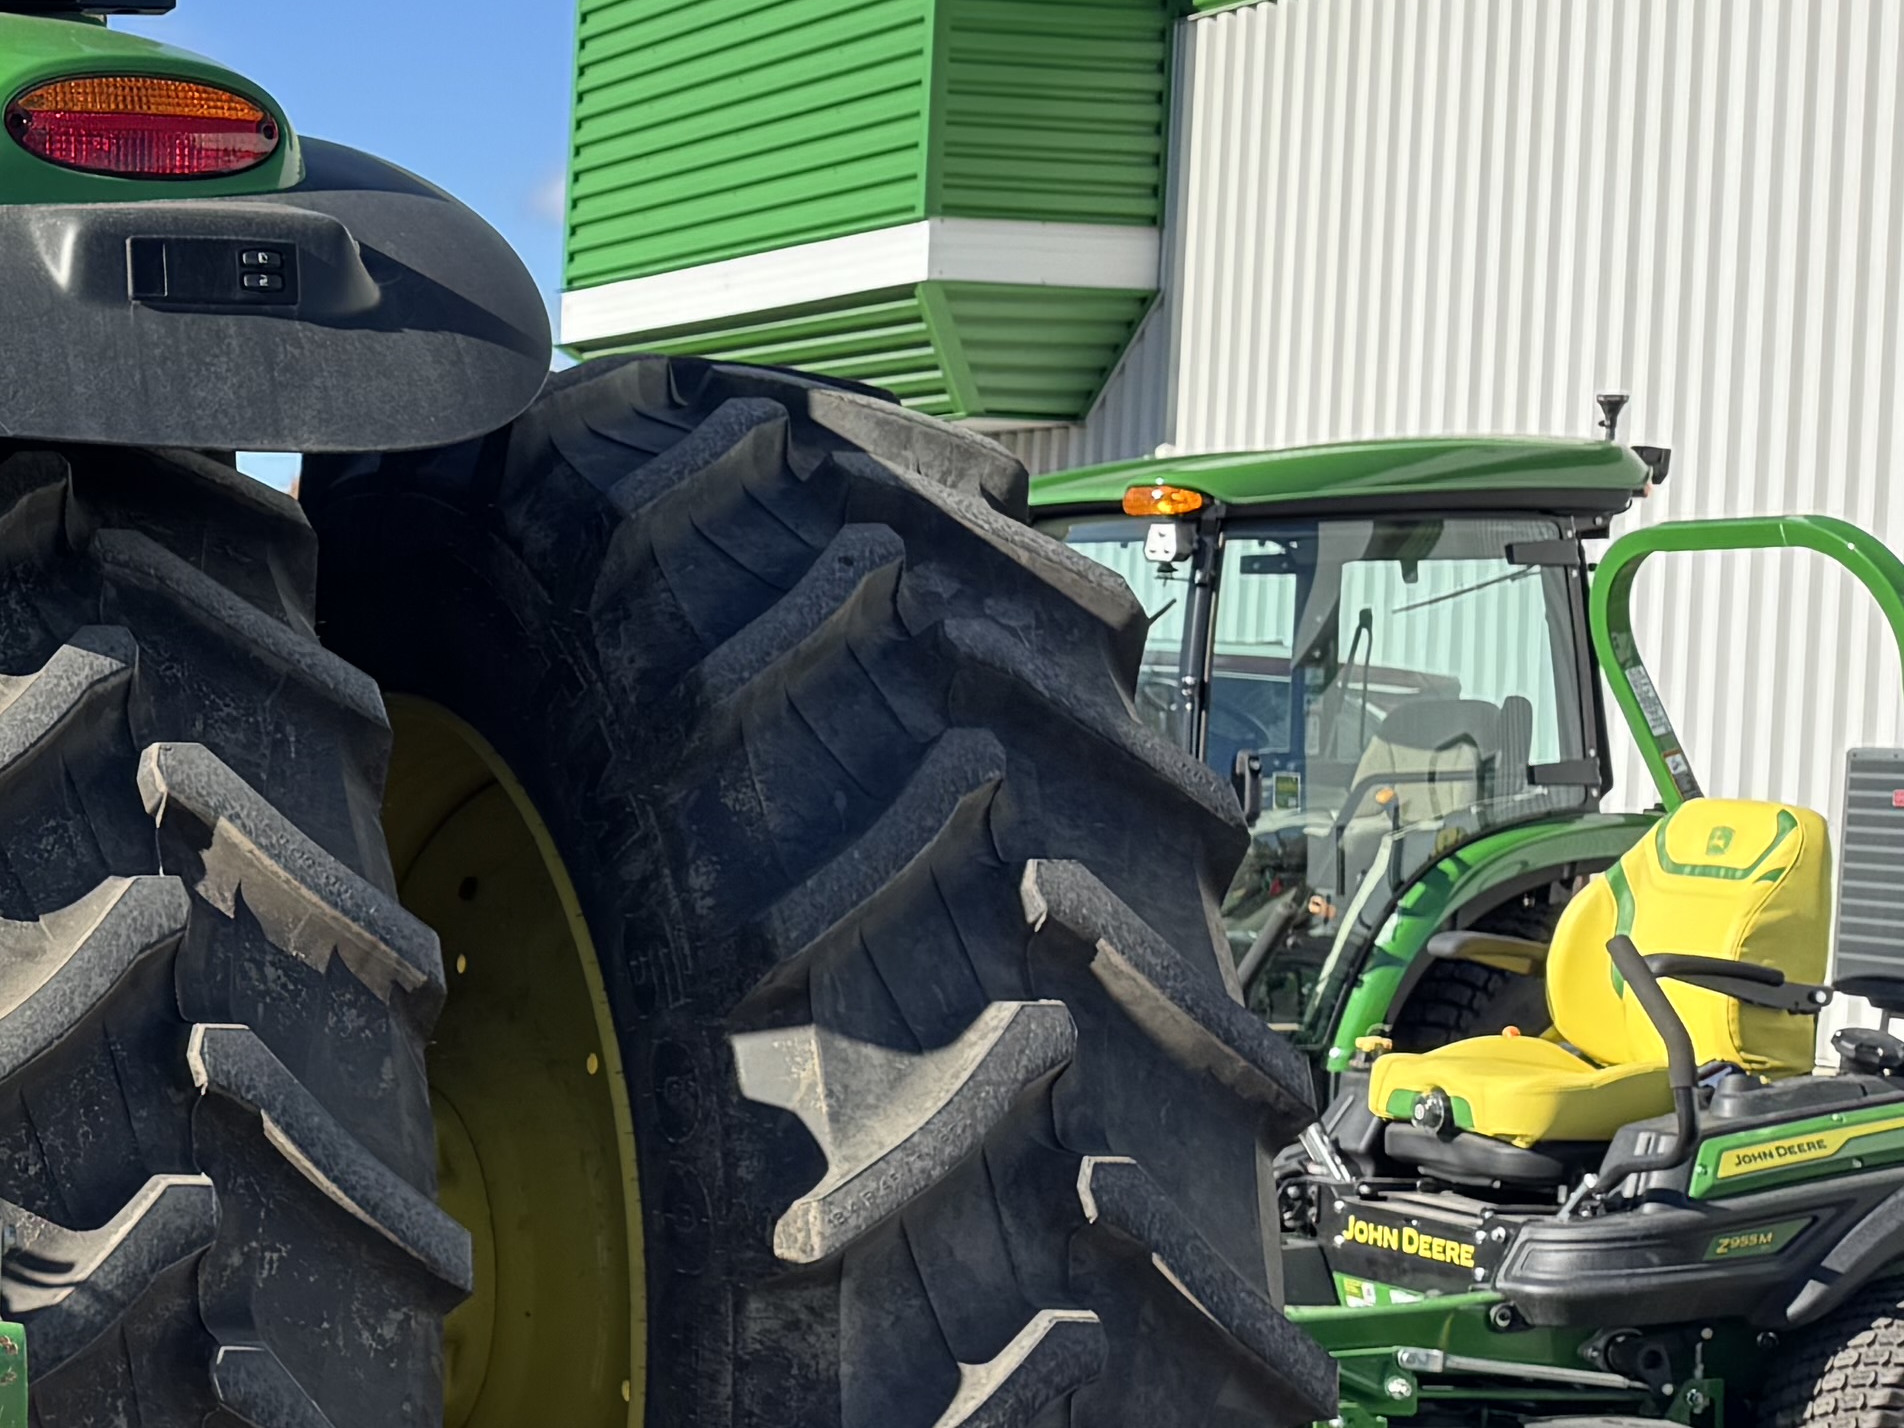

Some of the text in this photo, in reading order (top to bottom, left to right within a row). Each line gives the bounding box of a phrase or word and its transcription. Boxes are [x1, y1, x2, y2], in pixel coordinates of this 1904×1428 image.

[1735, 1139, 1827, 1167] JOHN DEERE
[1342, 1215, 1475, 1268] JOHN DEERE
